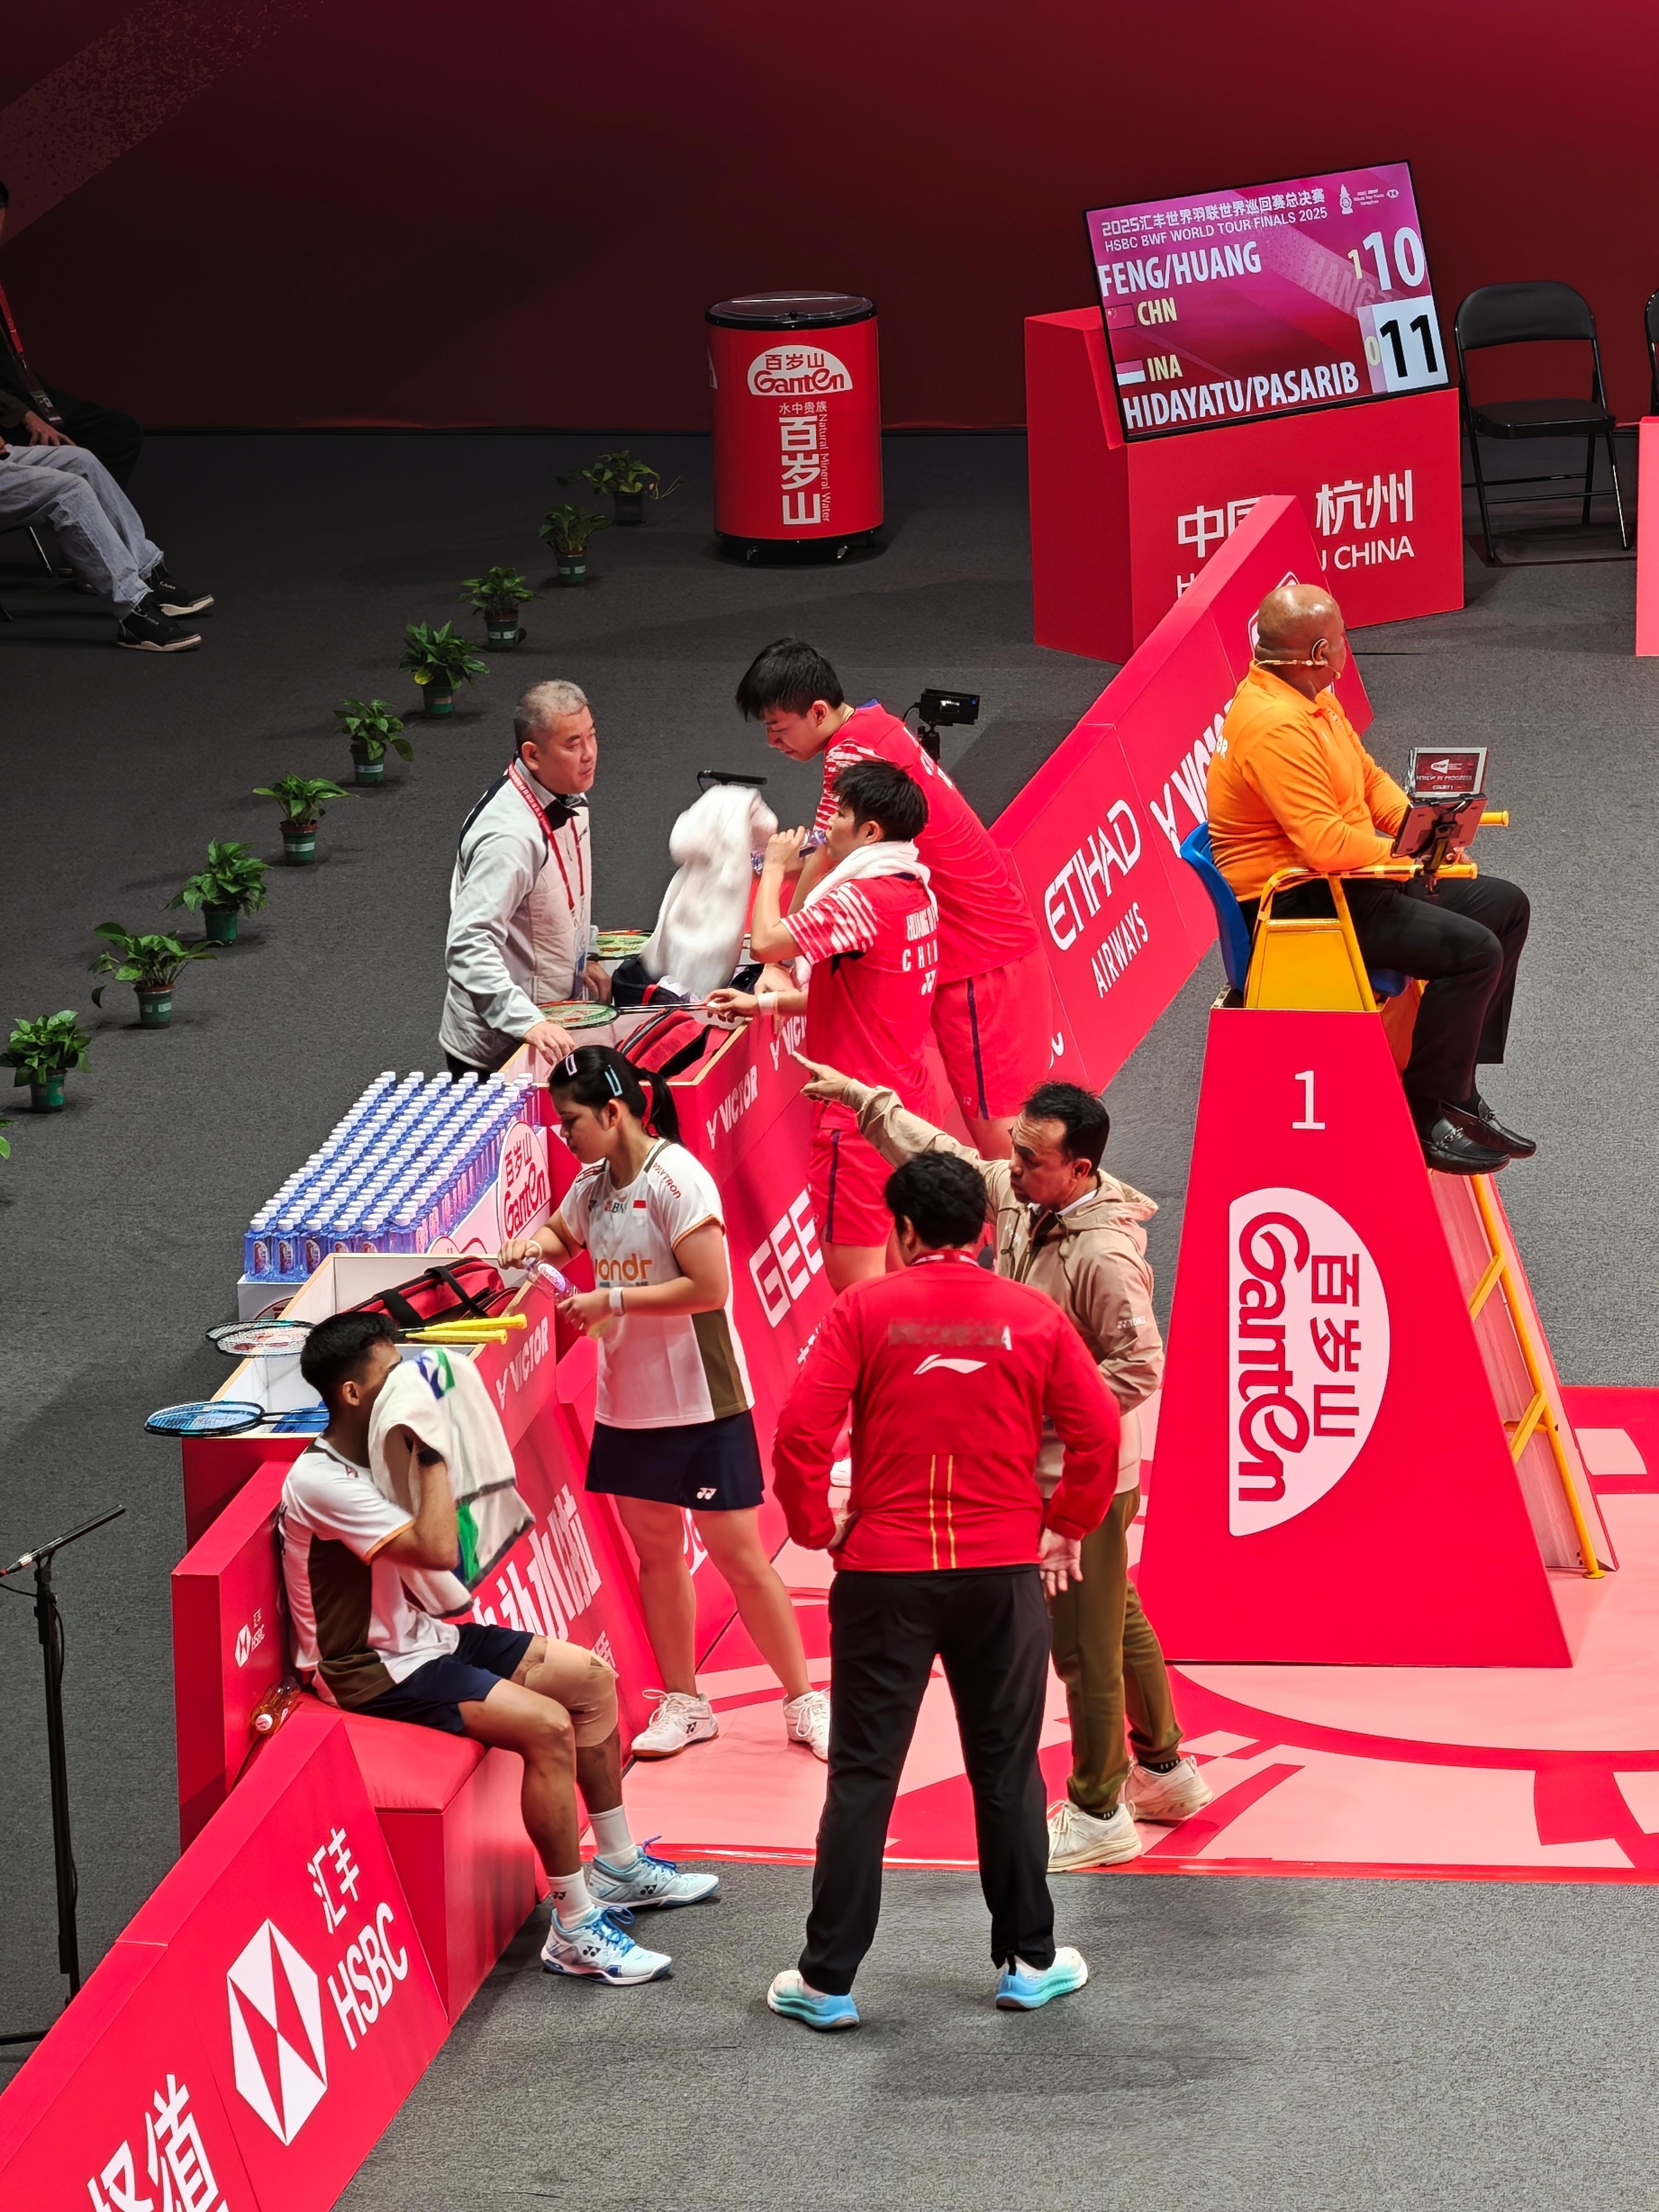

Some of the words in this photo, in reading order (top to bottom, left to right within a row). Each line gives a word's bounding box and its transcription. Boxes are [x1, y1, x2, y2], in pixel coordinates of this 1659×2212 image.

[1105, 237, 1138, 252] HSBC
[1141, 233, 1167, 246] BWF
[1172, 224, 1215, 242] WORLD
[1218, 219, 1252, 234] TOUR
[1253, 211, 1296, 229] FINALS
[1299, 207, 1327, 222] 2025
[1348, 249, 1363, 279] 1
[1363, 227, 1425, 291] 10
[1098, 241, 1262, 296] FENG/HUANG
[1137, 297, 1177, 326] CHN
[765, 353, 825, 370] 百岁山
[1147, 355, 1183, 382] INA
[1365, 335, 1380, 366] 0
[1380, 314, 1438, 377] 11
[779, 401, 828, 415] 水中贵族
[1123, 362, 1359, 429] HIDAYATU/PASARIB
[819, 414, 829, 450] Natural
[779, 415, 821, 525] 百岁山
[820, 453, 831, 490] Mineral
[821, 492, 832, 522] Water
[1316, 470, 1413, 536] 杭州
[1334, 535, 1415, 570] CHINA
[1043, 799, 1142, 951] ETIHAD
[1090, 902, 1149, 999] AIRWAYS
[719, 1064, 758, 1133] VICTOR
[1291, 1070, 1326, 1130] 1
[509, 1316, 549, 1392] VICTOR
[1310, 1252, 1361, 1438] 百岁山
[307, 1827, 360, 1934] 汇丰
[327, 1901, 409, 2051] HSBC
